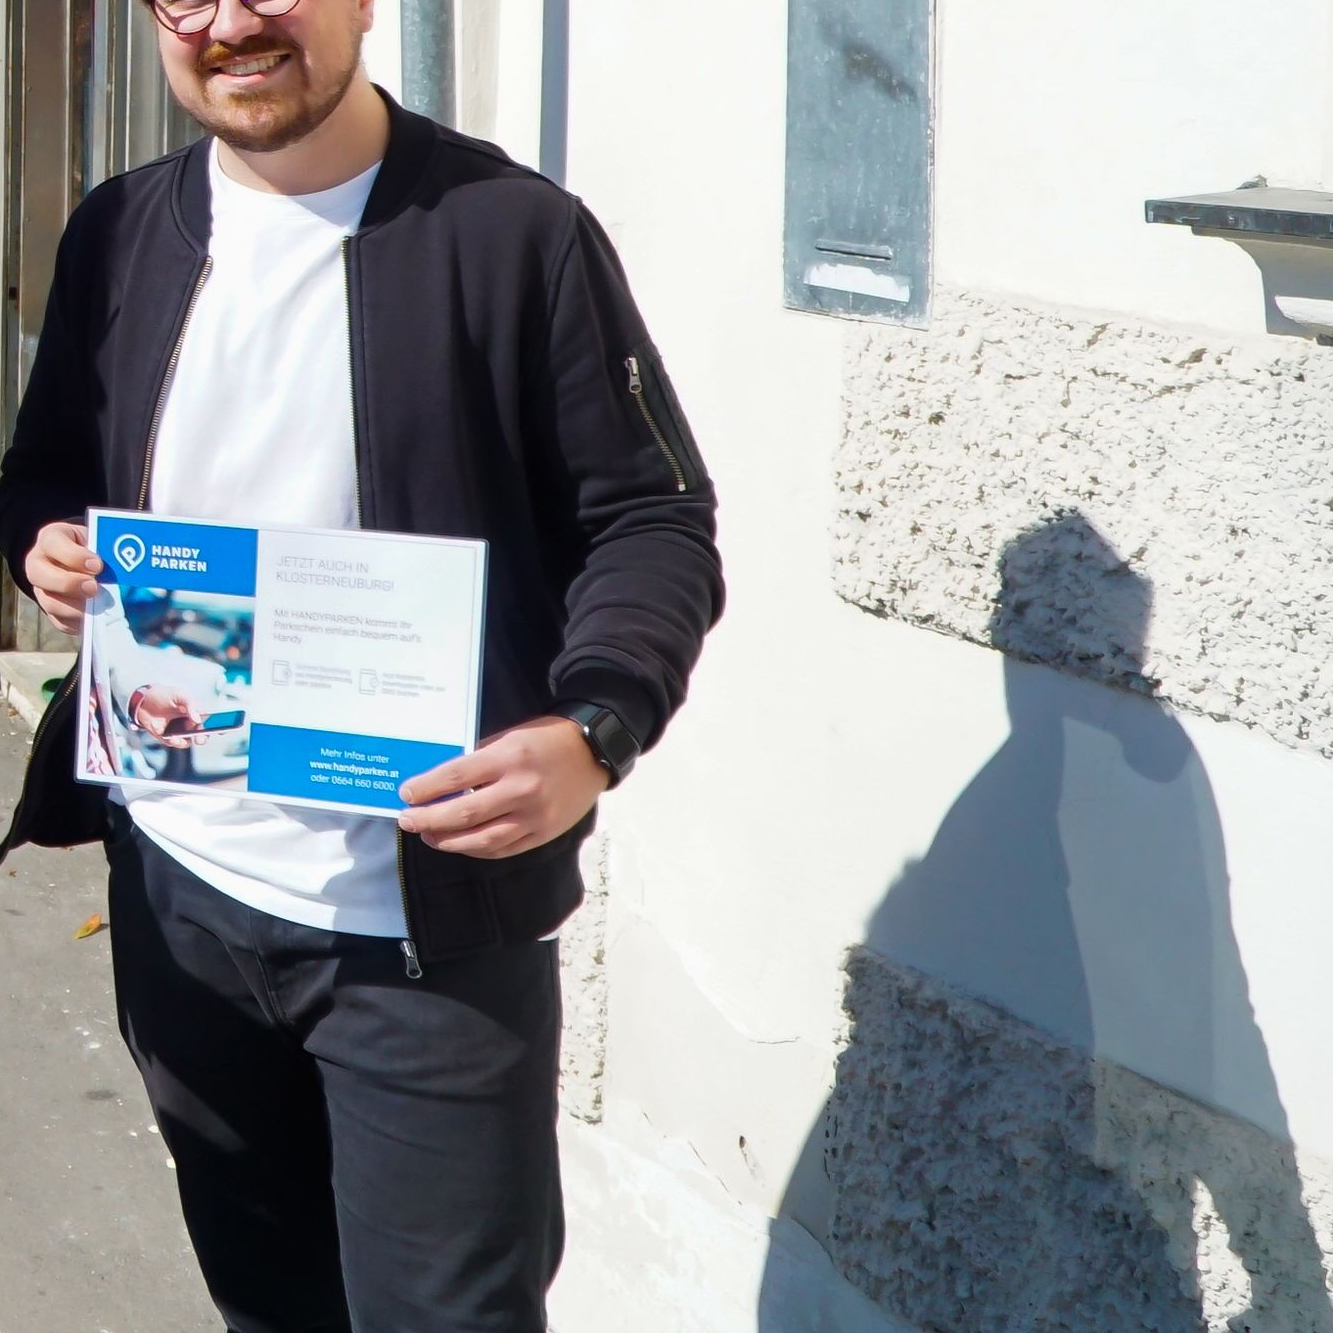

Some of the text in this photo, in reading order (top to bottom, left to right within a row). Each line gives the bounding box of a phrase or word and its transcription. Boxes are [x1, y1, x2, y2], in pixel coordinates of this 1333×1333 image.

[151, 544, 201, 559] HANDY
[151, 557, 208, 572] PARKEN
[276, 556, 370, 574] JETZT AUCH IN
[276, 571, 395, 592] KLOSTERNEUBURG!
[291, 610, 363, 625] HANDYPARKEN
[320, 747, 390, 764] Mehr Infos unter
[309, 760, 400, 779] www.handyparken.at
[310, 773, 330, 783] oder
[331, 775, 353, 786] 0664
[354, 778, 372, 789] 660
